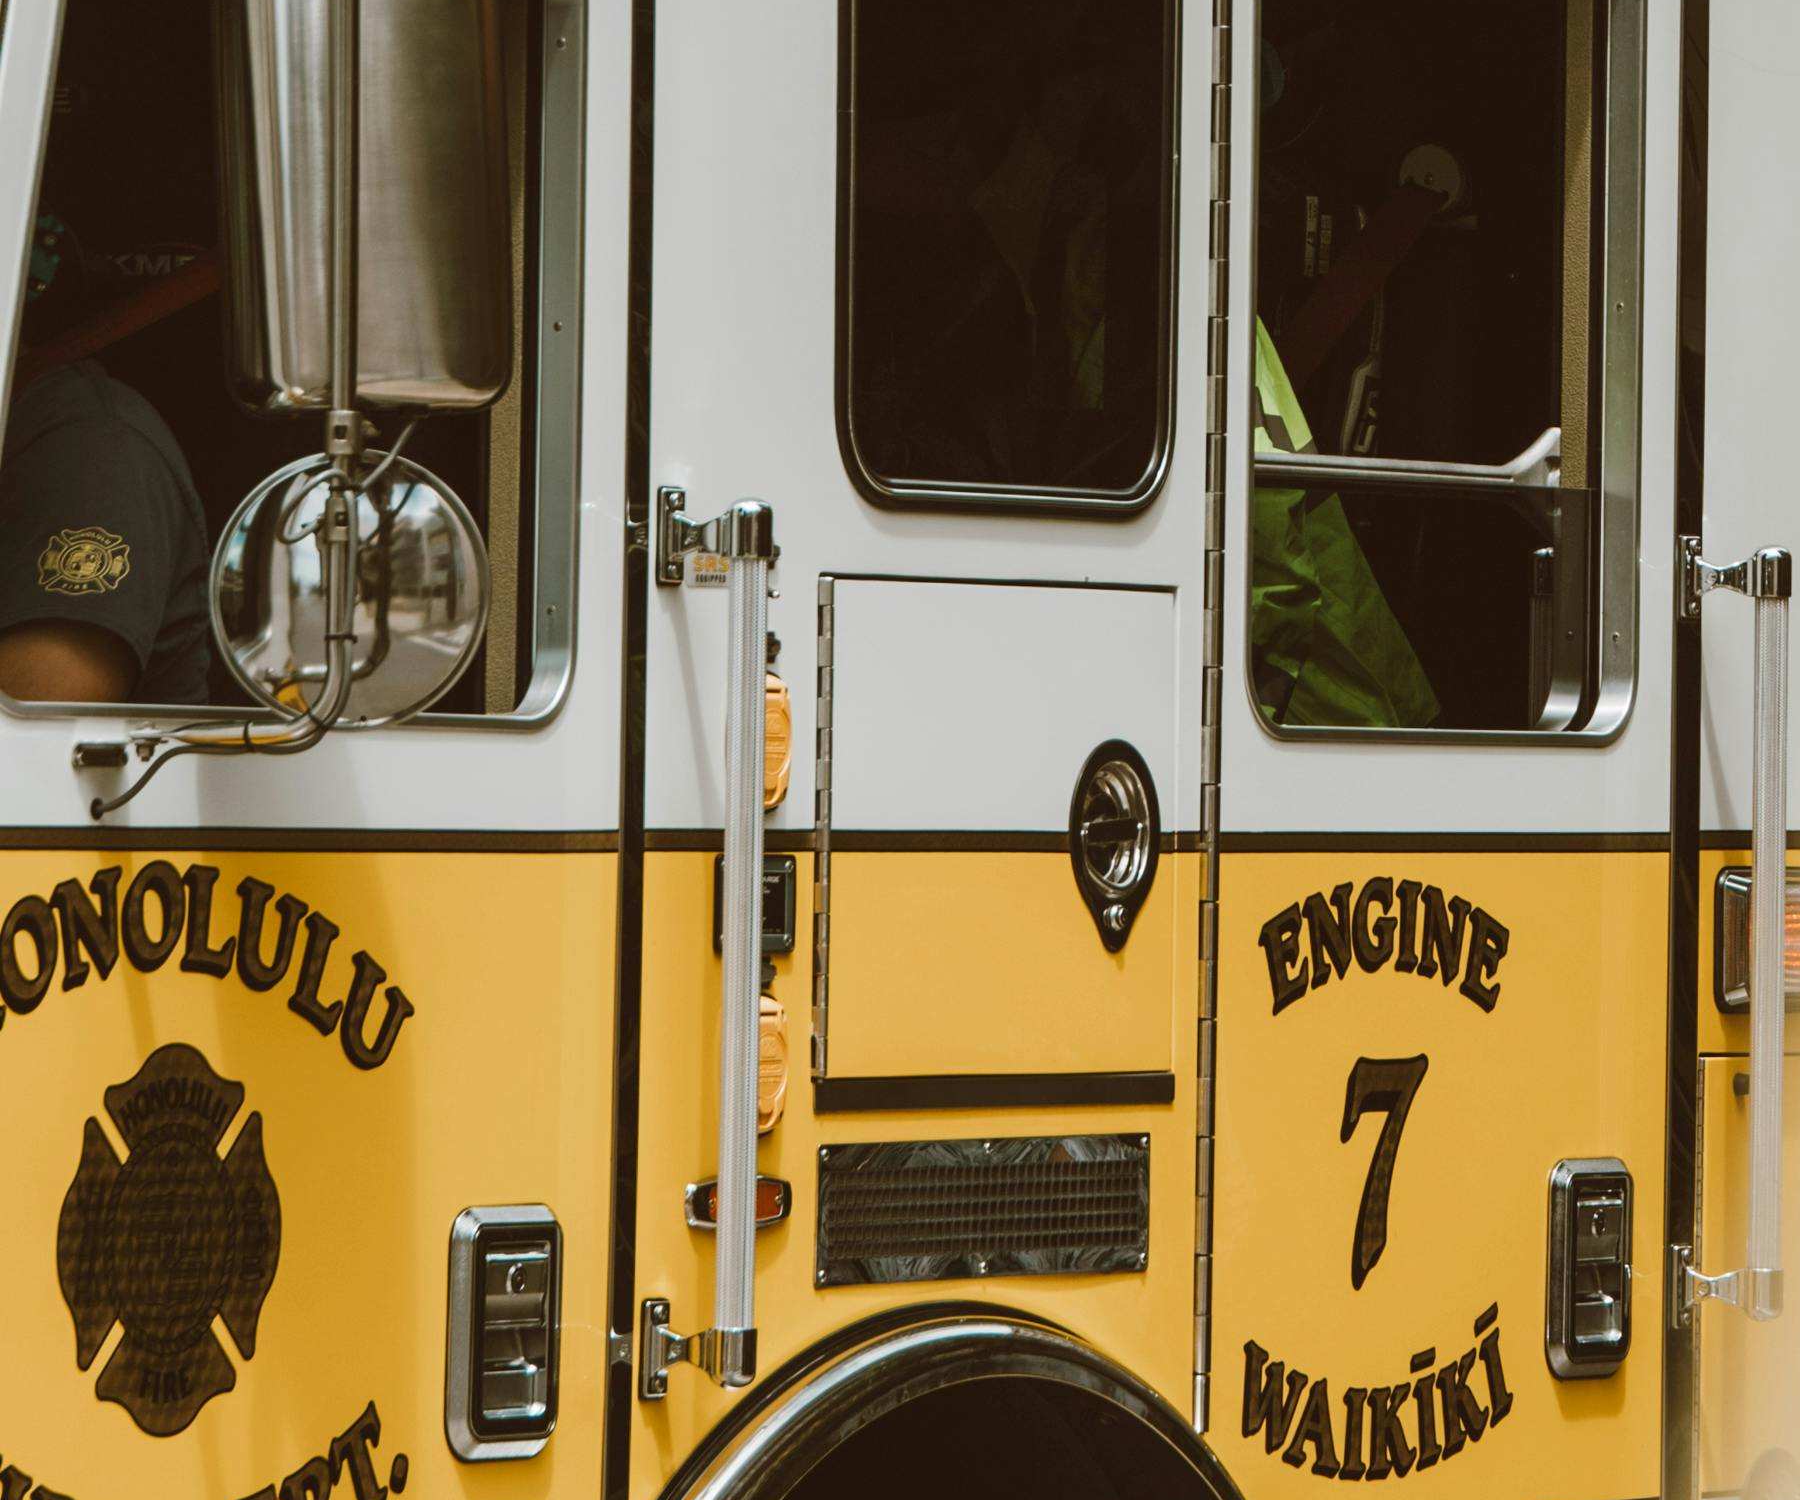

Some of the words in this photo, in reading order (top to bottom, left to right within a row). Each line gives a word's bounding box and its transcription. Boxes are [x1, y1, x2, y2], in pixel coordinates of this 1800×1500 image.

[0, 859, 416, 1071] ONOLULU
[1257, 876, 1510, 1016] ENGINE
[1341, 1053, 1429, 1291] 7
[137, 1367, 195, 1403] FIRE
